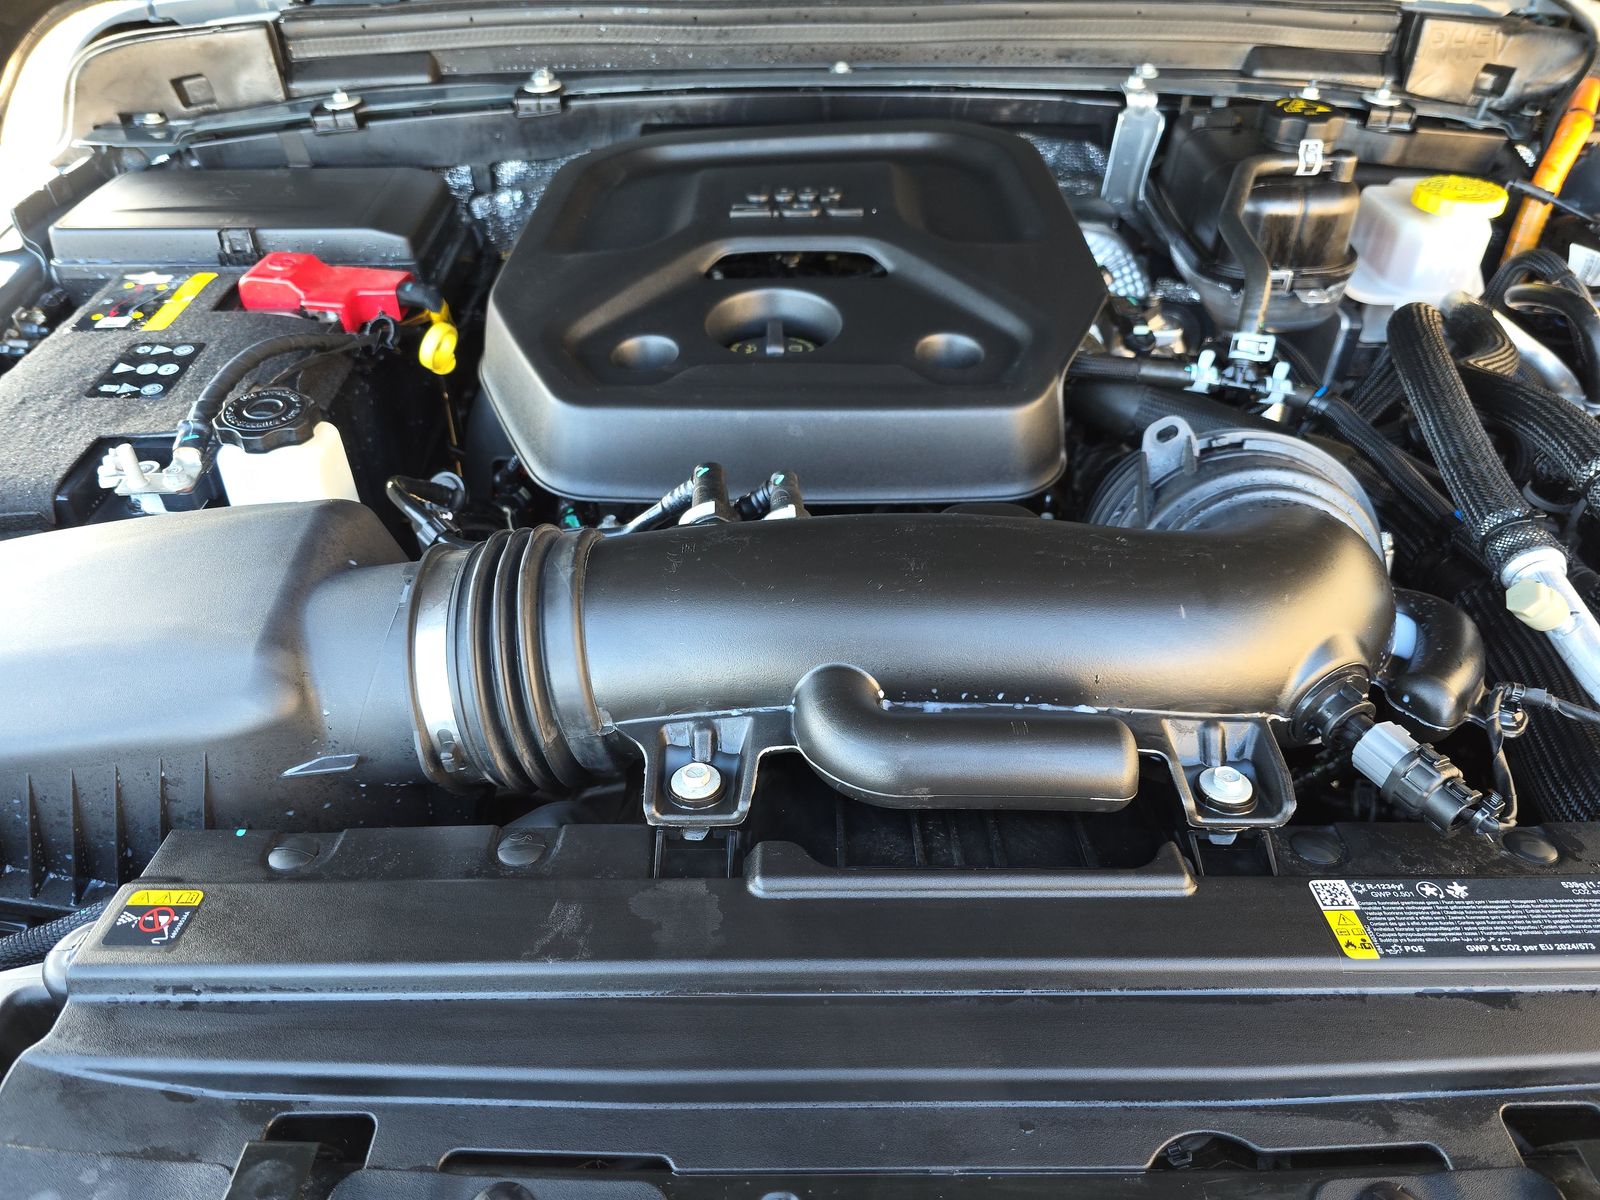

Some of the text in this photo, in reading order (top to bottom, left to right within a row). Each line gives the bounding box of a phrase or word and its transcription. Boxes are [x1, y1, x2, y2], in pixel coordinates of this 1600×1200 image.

[1404, 945, 1426, 953] POE
[1466, 944, 1488, 952] GWP
[1491, 944, 1500, 952] &
[1500, 944, 1521, 952] CO2
[1523, 945, 1538, 953] per
[1539, 943, 1554, 951] EU
